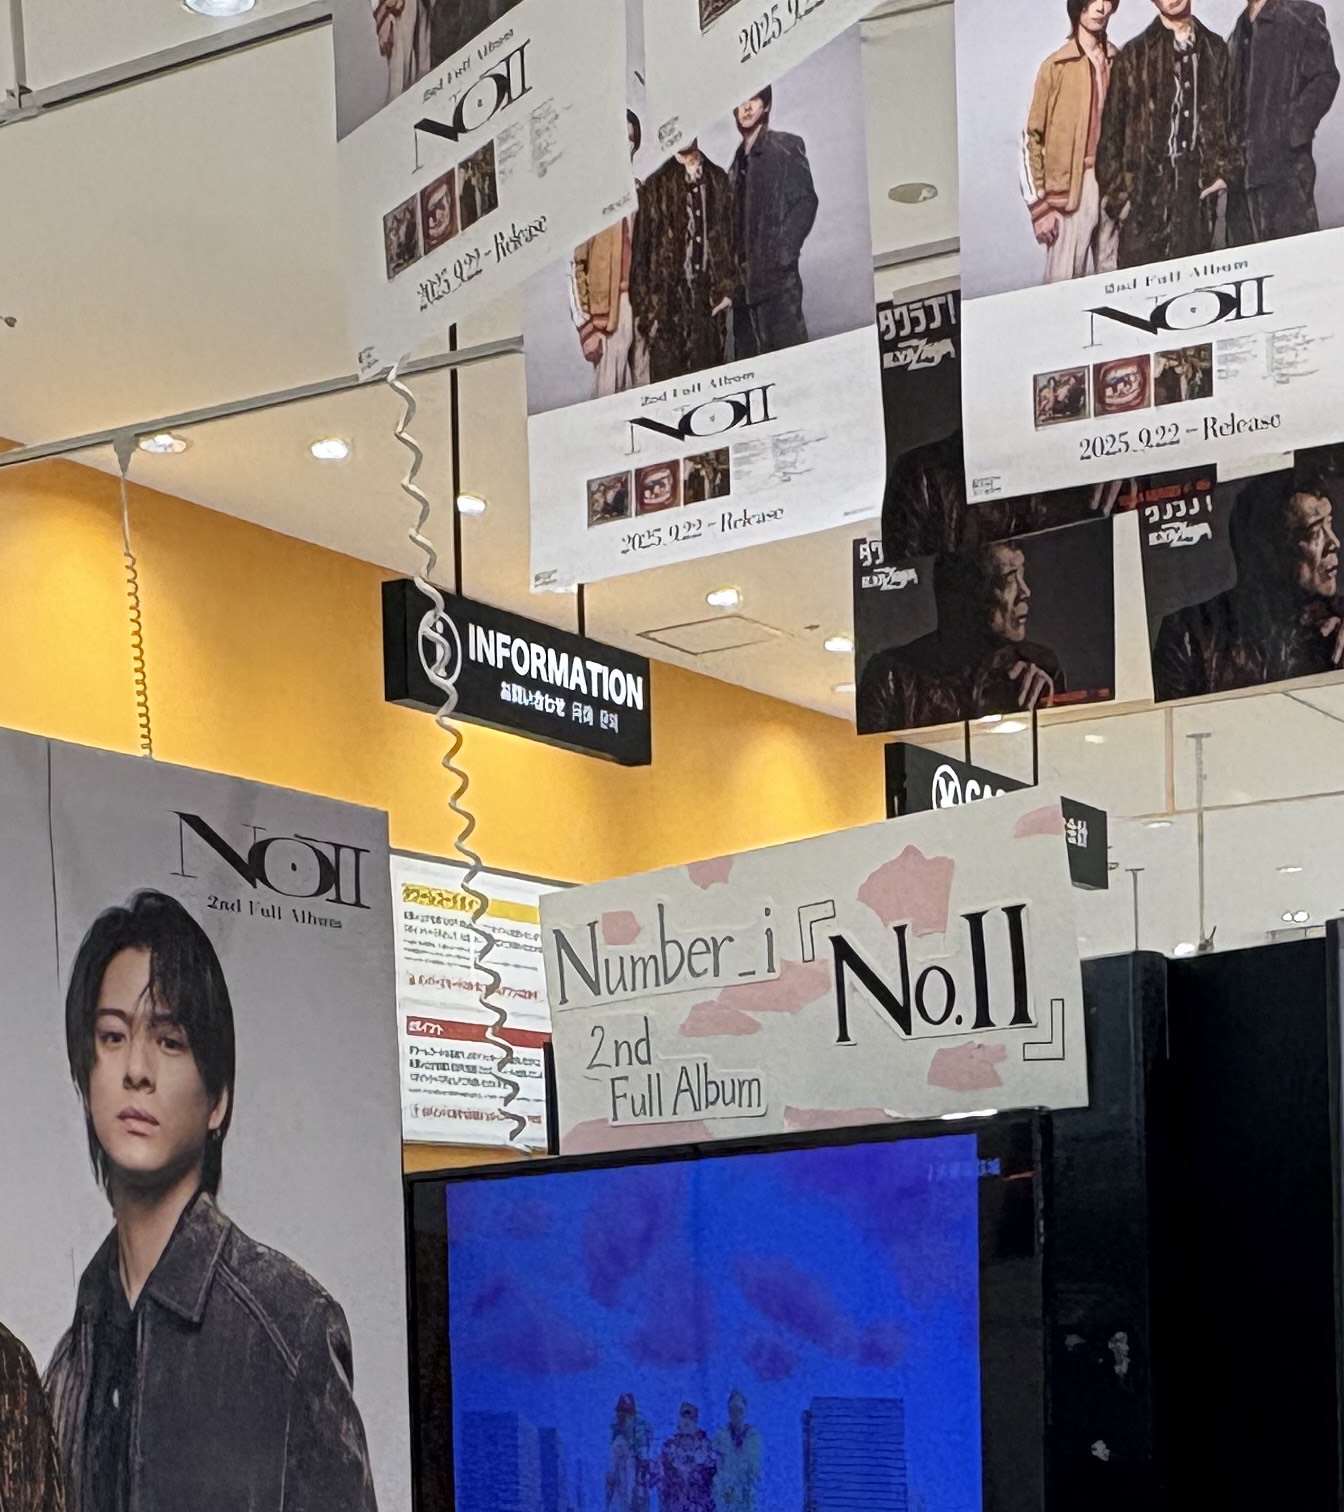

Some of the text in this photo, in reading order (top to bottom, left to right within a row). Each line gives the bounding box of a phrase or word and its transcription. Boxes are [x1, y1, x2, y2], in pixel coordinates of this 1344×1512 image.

[468, 622, 644, 710] INFORMATION
[553, 903, 775, 1006] Number_i
[586, 1016, 652, 1070] 2nd
[610, 1062, 762, 1121] Full Album
